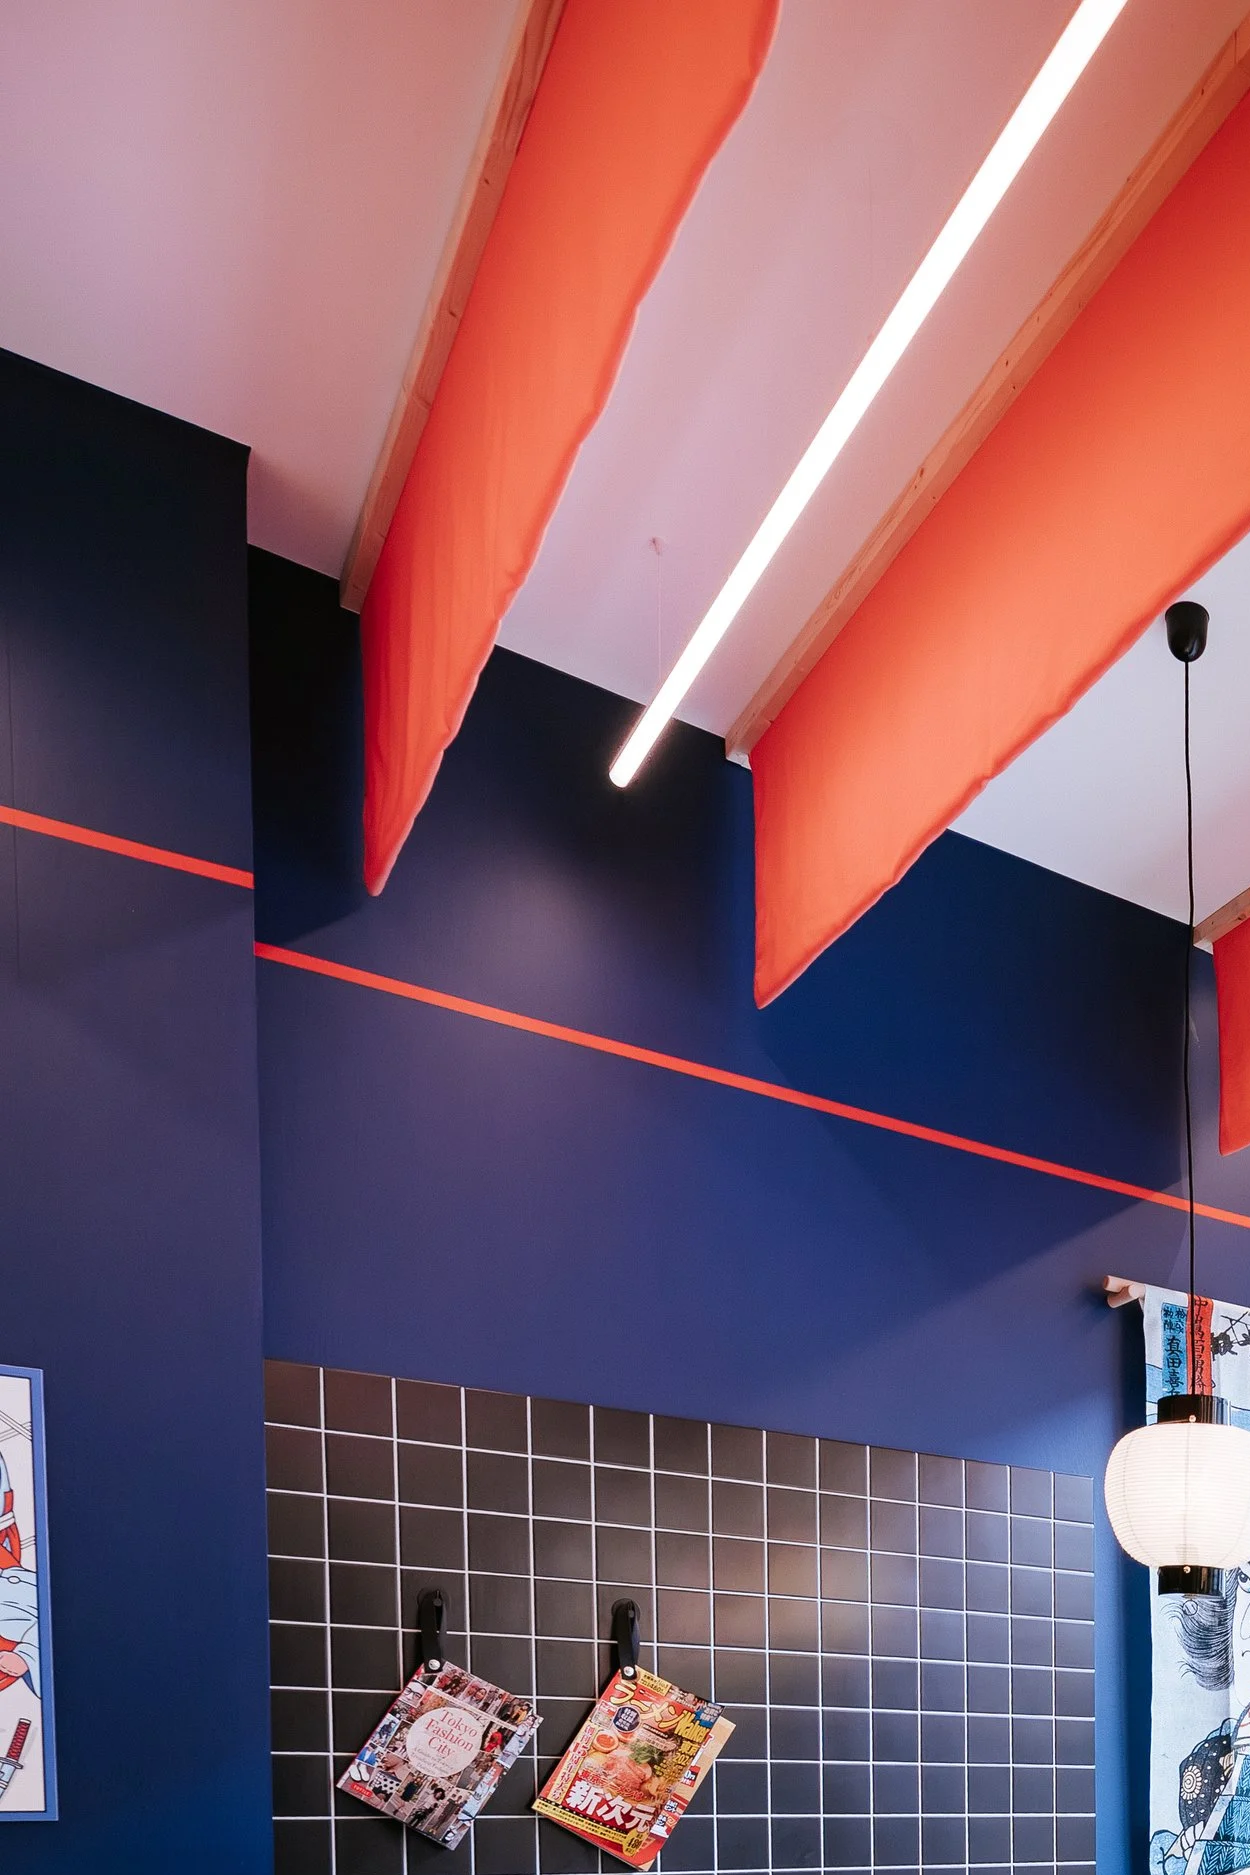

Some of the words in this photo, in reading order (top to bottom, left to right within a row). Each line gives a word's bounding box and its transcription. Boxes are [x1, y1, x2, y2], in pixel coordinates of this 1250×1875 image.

[425, 1718, 474, 1752] Fashion
[440, 1709, 478, 1737] Tokyo
[428, 1737, 455, 1759] City
[565, 1780, 656, 1833] 新次元
